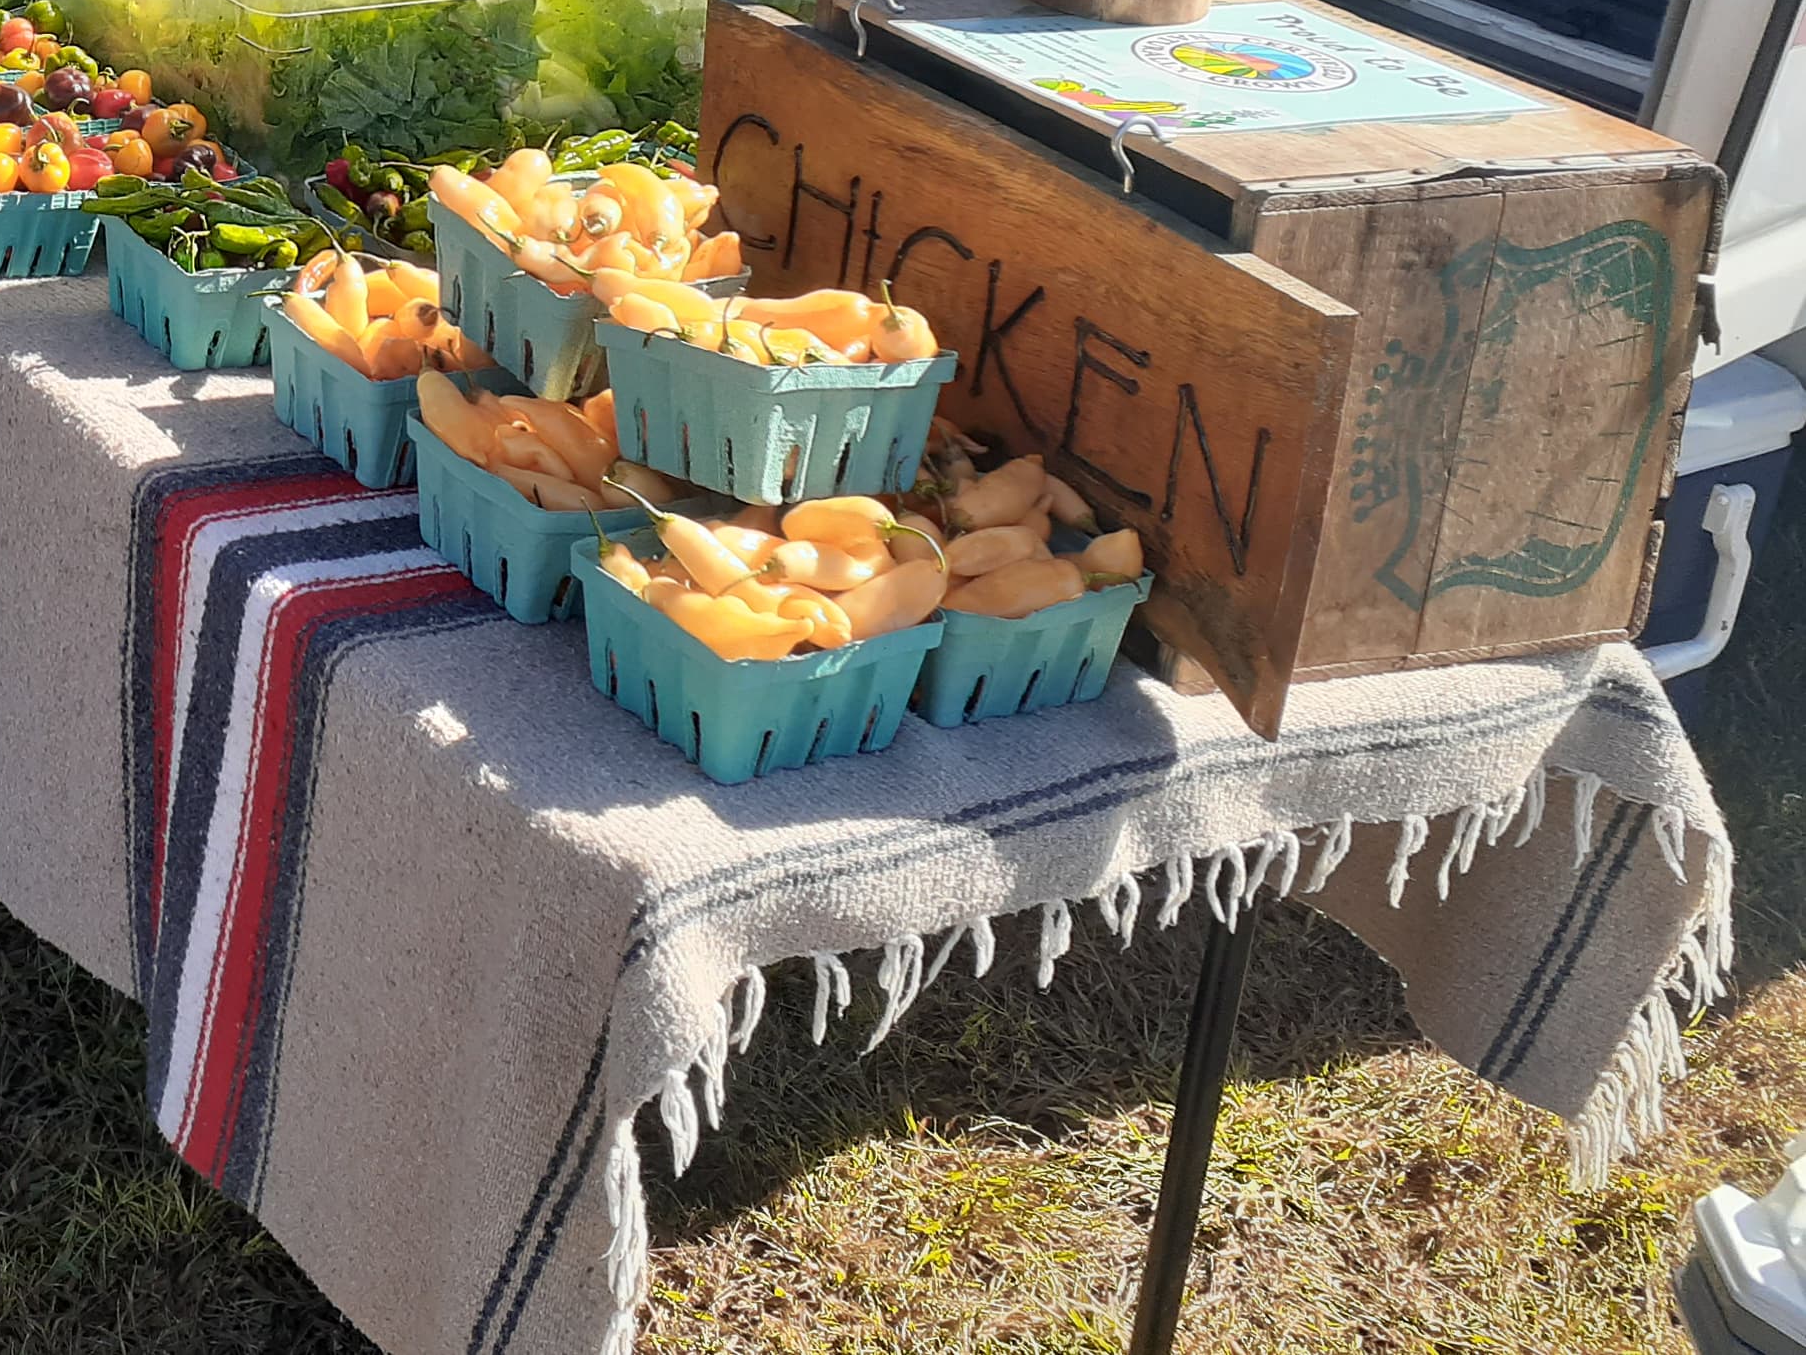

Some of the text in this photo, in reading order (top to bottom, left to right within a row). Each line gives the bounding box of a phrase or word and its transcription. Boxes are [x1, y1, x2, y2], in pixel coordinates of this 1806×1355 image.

[1141, 33, 1210, 74] NATURALLY
[1243, 37, 1346, 81] CERTIFIED
[1256, 12, 1470, 101] Proud to Be
[1208, 75, 1322, 89] GROWN
